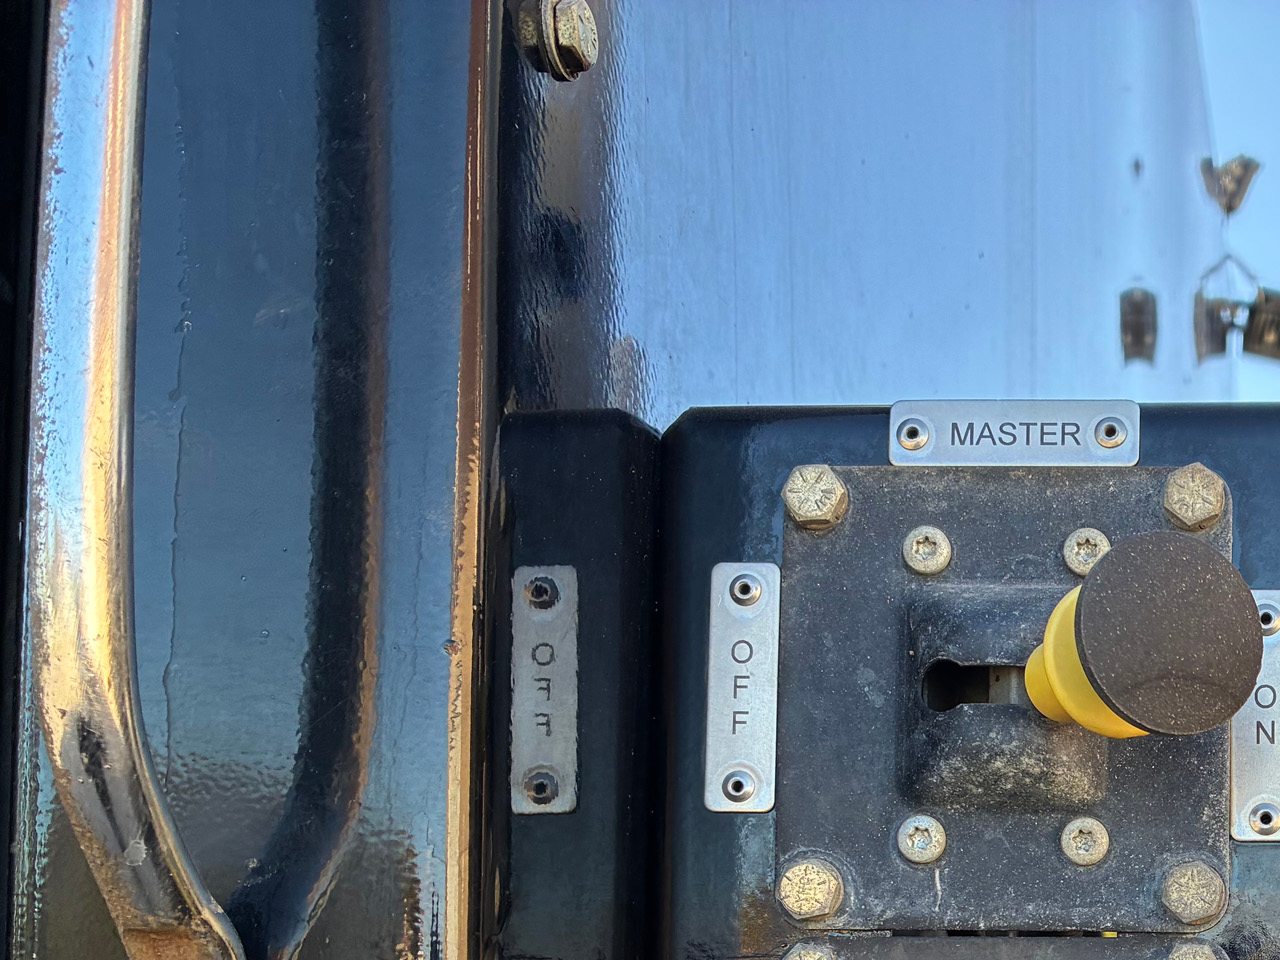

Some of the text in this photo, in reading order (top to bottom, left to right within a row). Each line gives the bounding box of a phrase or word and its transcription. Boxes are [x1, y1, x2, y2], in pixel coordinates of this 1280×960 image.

[950, 421, 1082, 446] MASTER
[730, 639, 754, 735] OFF
[1254, 684, 1277, 745] ON
